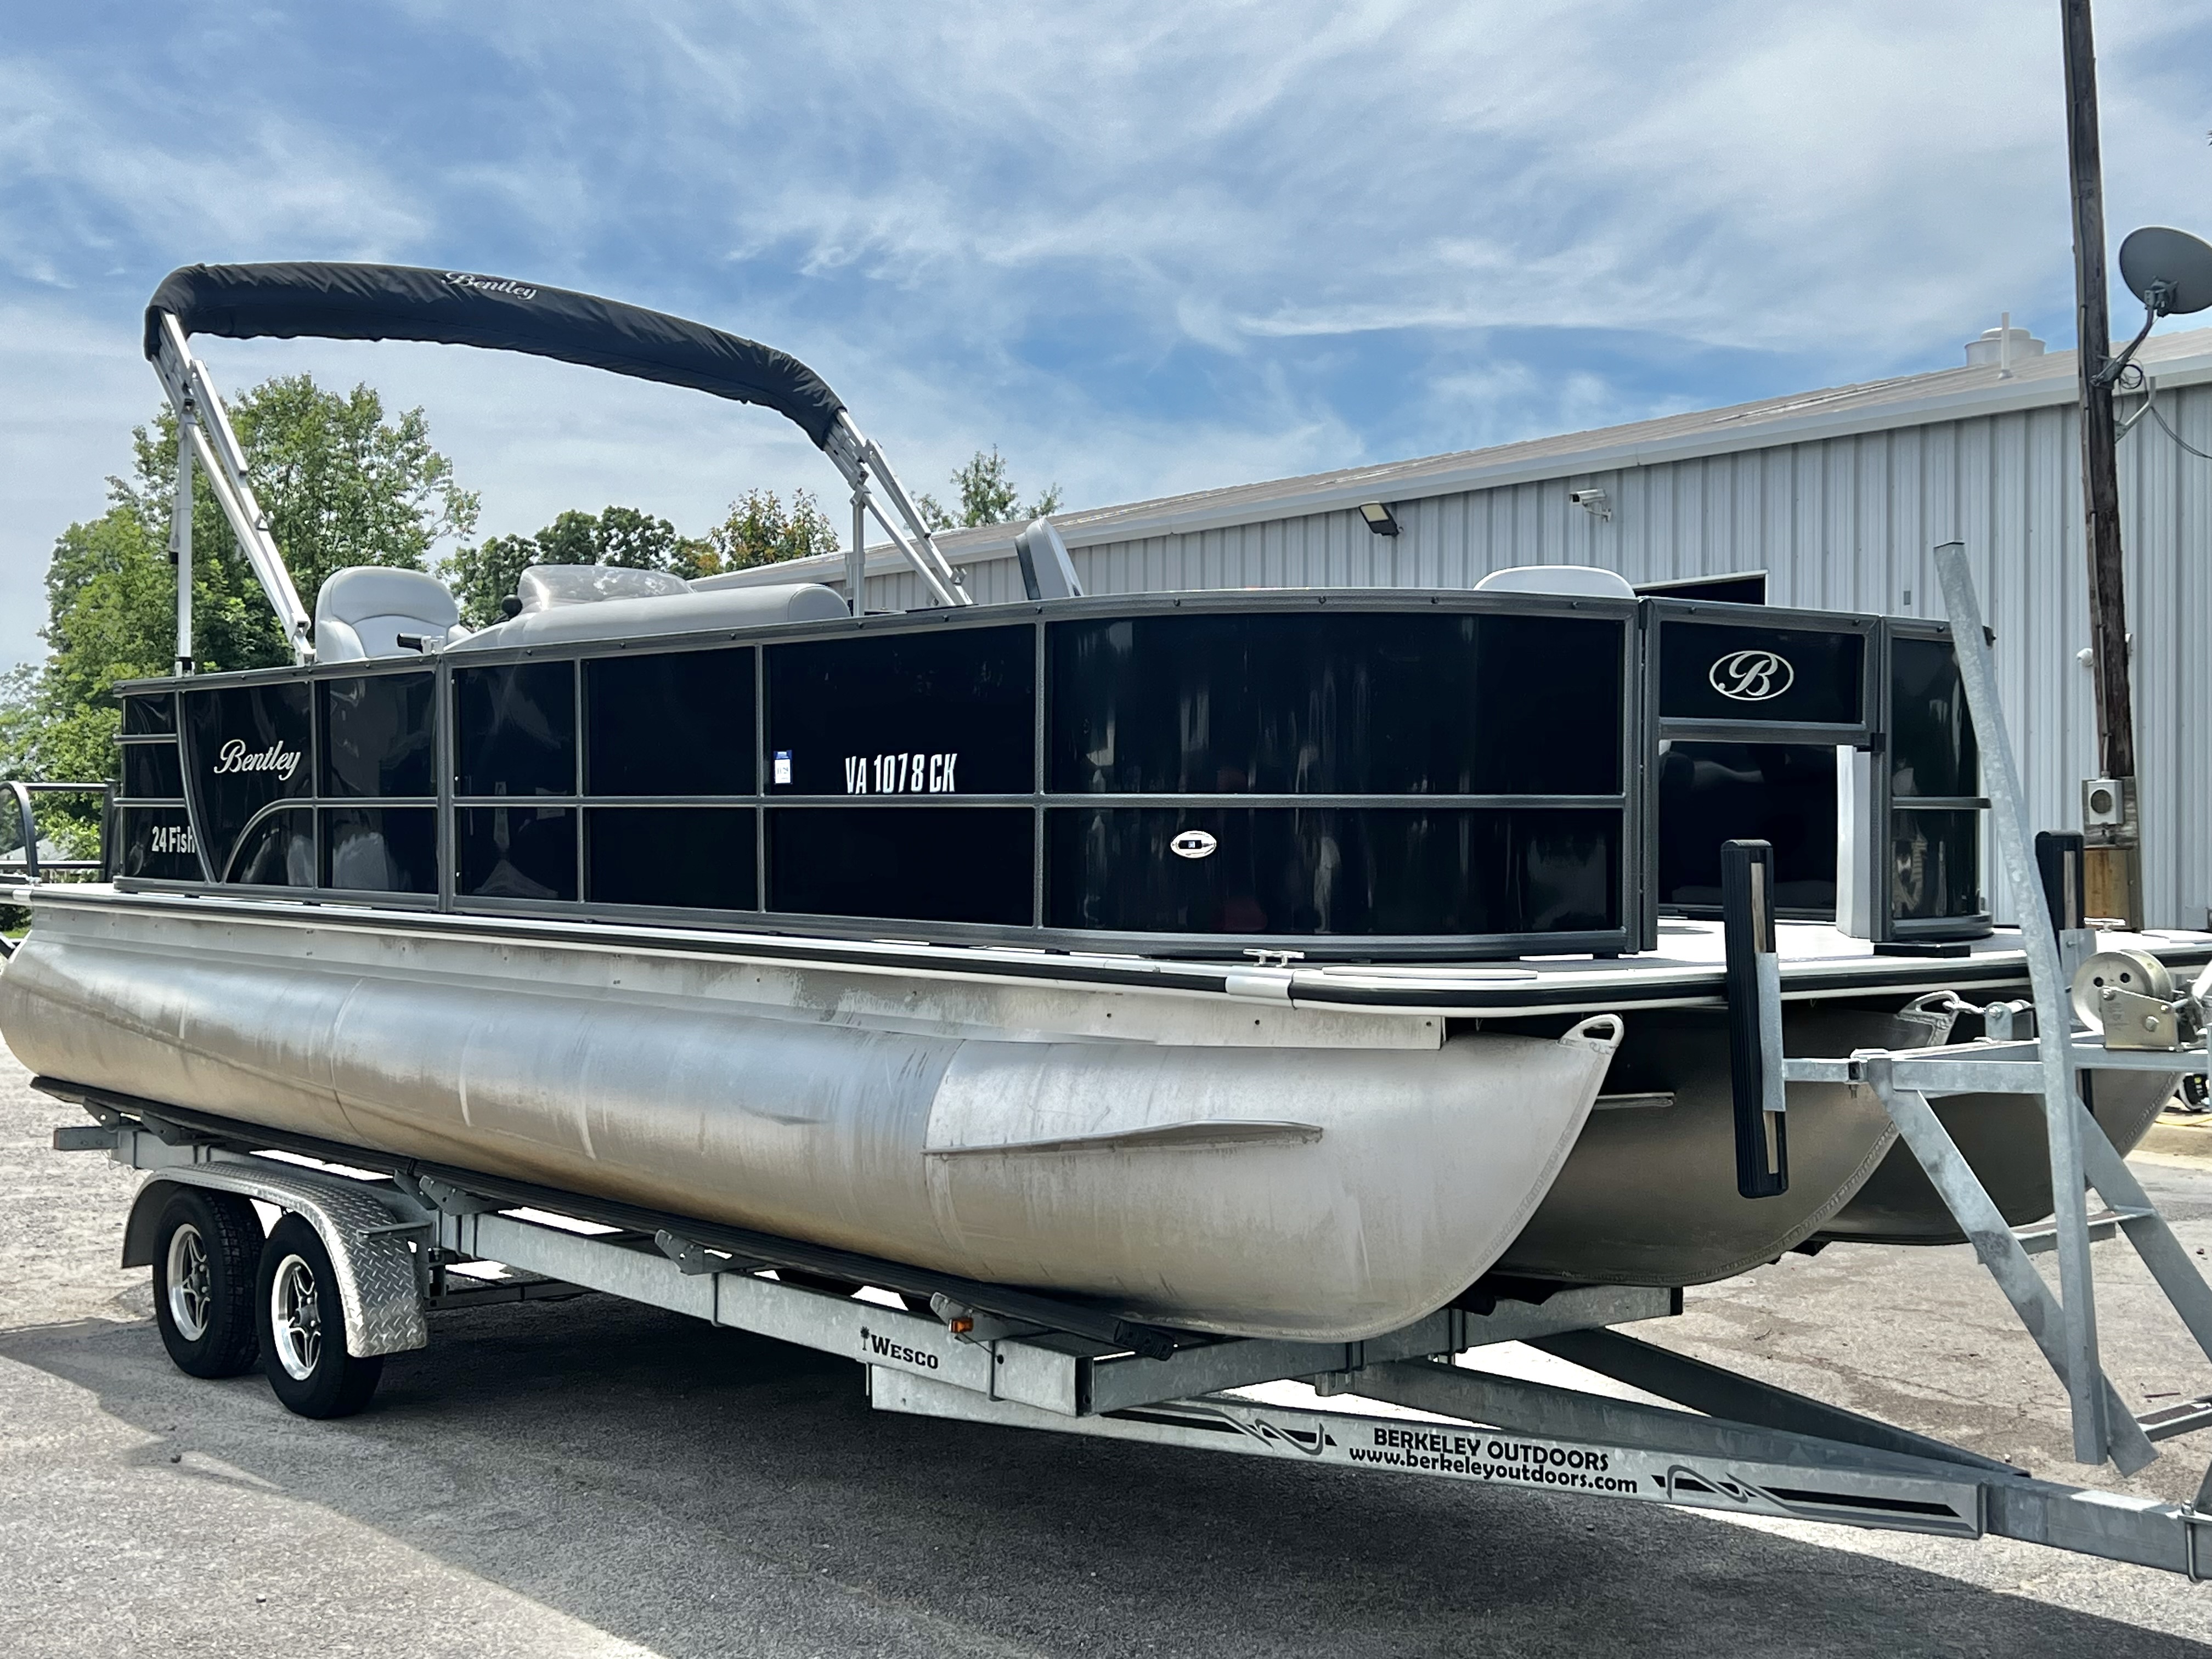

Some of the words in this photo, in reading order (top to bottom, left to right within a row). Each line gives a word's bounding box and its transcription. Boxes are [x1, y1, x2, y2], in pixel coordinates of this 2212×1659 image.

[441, 272, 537, 300] Bentley
[213, 739, 301, 781] Bentley
[845, 756, 867, 794] VA
[874, 753, 925, 794] 1078
[929, 753, 958, 793] CK
[151, 826, 167, 853] 24
[168, 826, 195, 853] Fish
[1374, 1427, 1481, 1457] BERKELEY
[1487, 1441, 1609, 1472] OUTDOORS
[1349, 1447, 1638, 1494] www.berkeleyoutdoors.com
